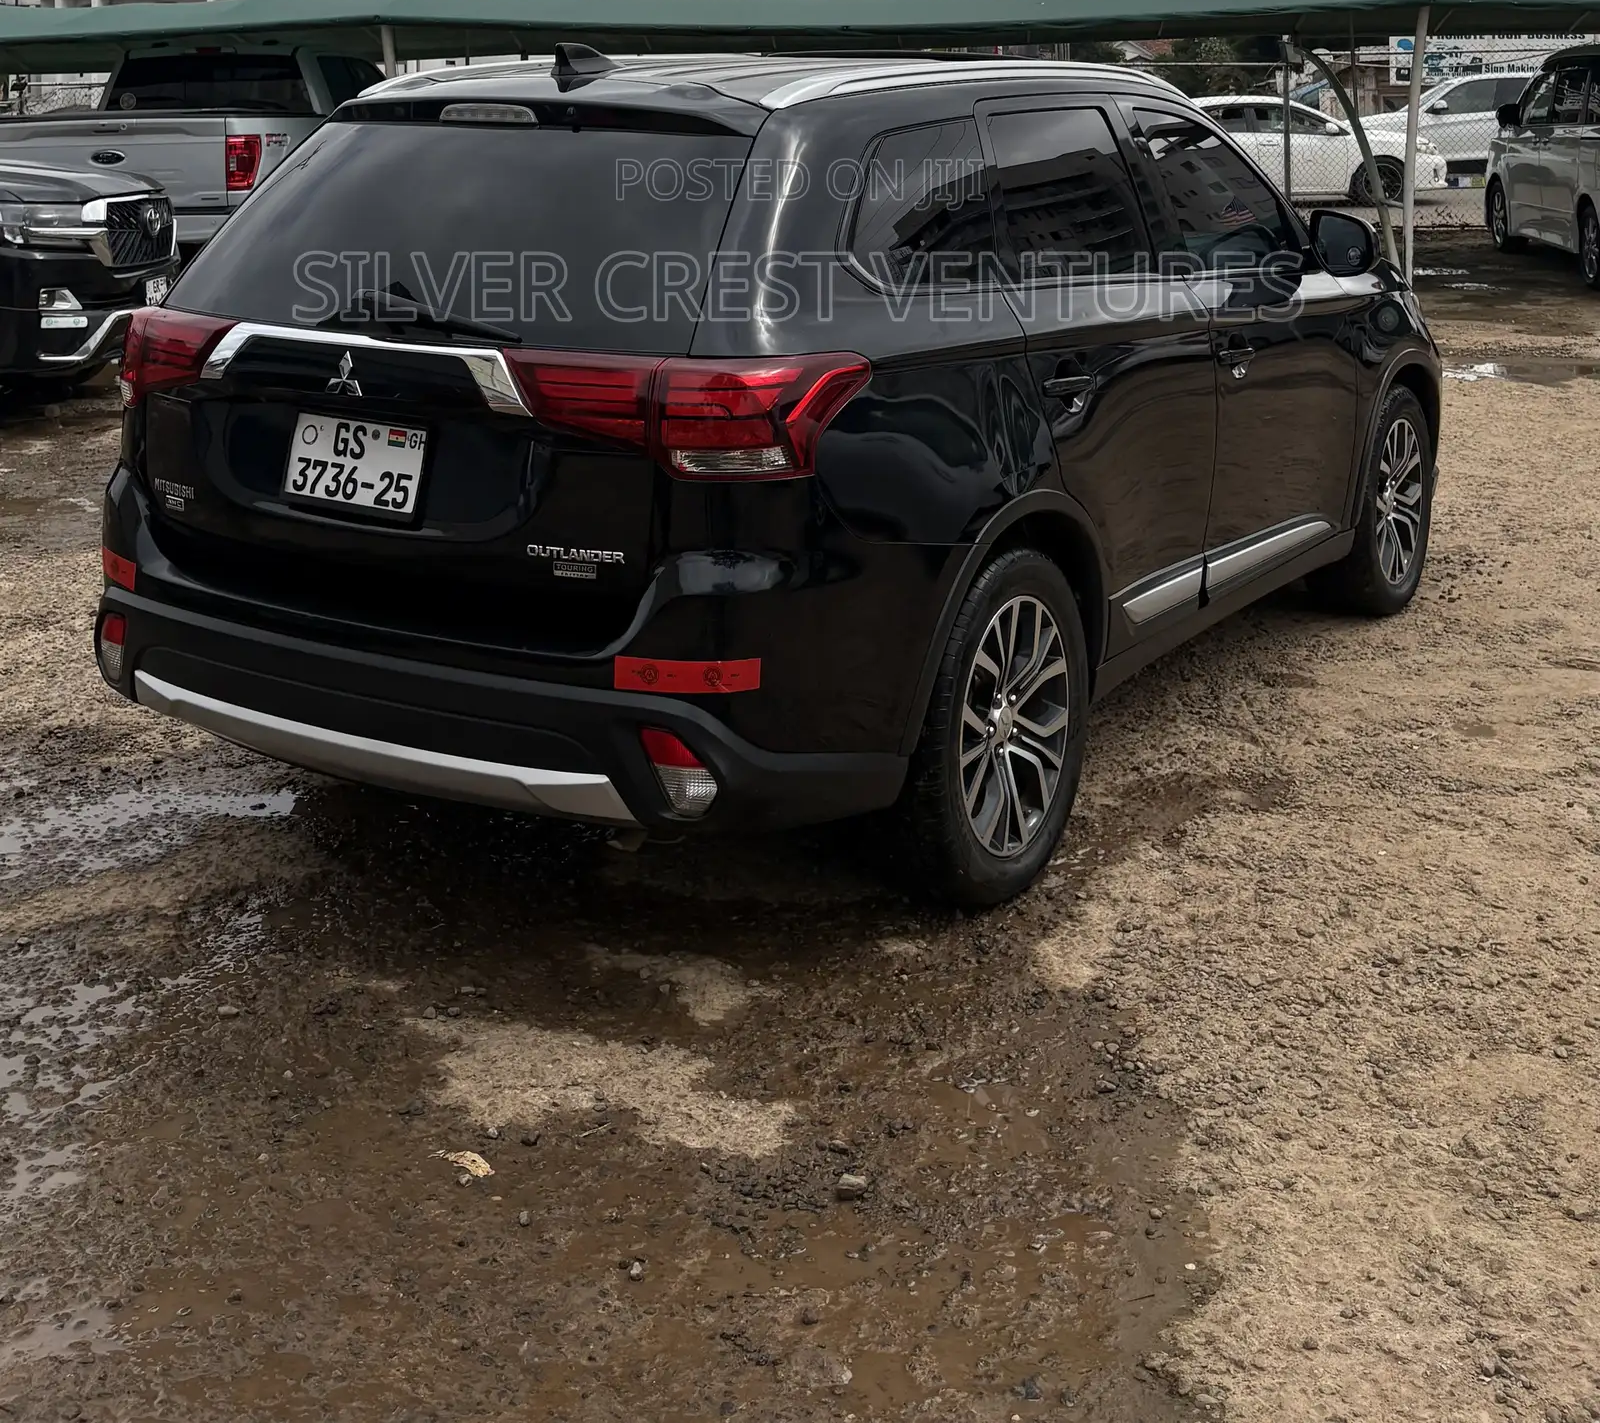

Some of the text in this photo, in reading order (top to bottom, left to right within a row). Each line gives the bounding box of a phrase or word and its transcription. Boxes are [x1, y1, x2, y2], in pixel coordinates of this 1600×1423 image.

[333, 422, 367, 460] GS
[154, 477, 194, 500] MITSUBISHI
[292, 456, 413, 509] 3736-25
[526, 544, 625, 564] OUTLANDER
[555, 563, 593, 573] TOURING
